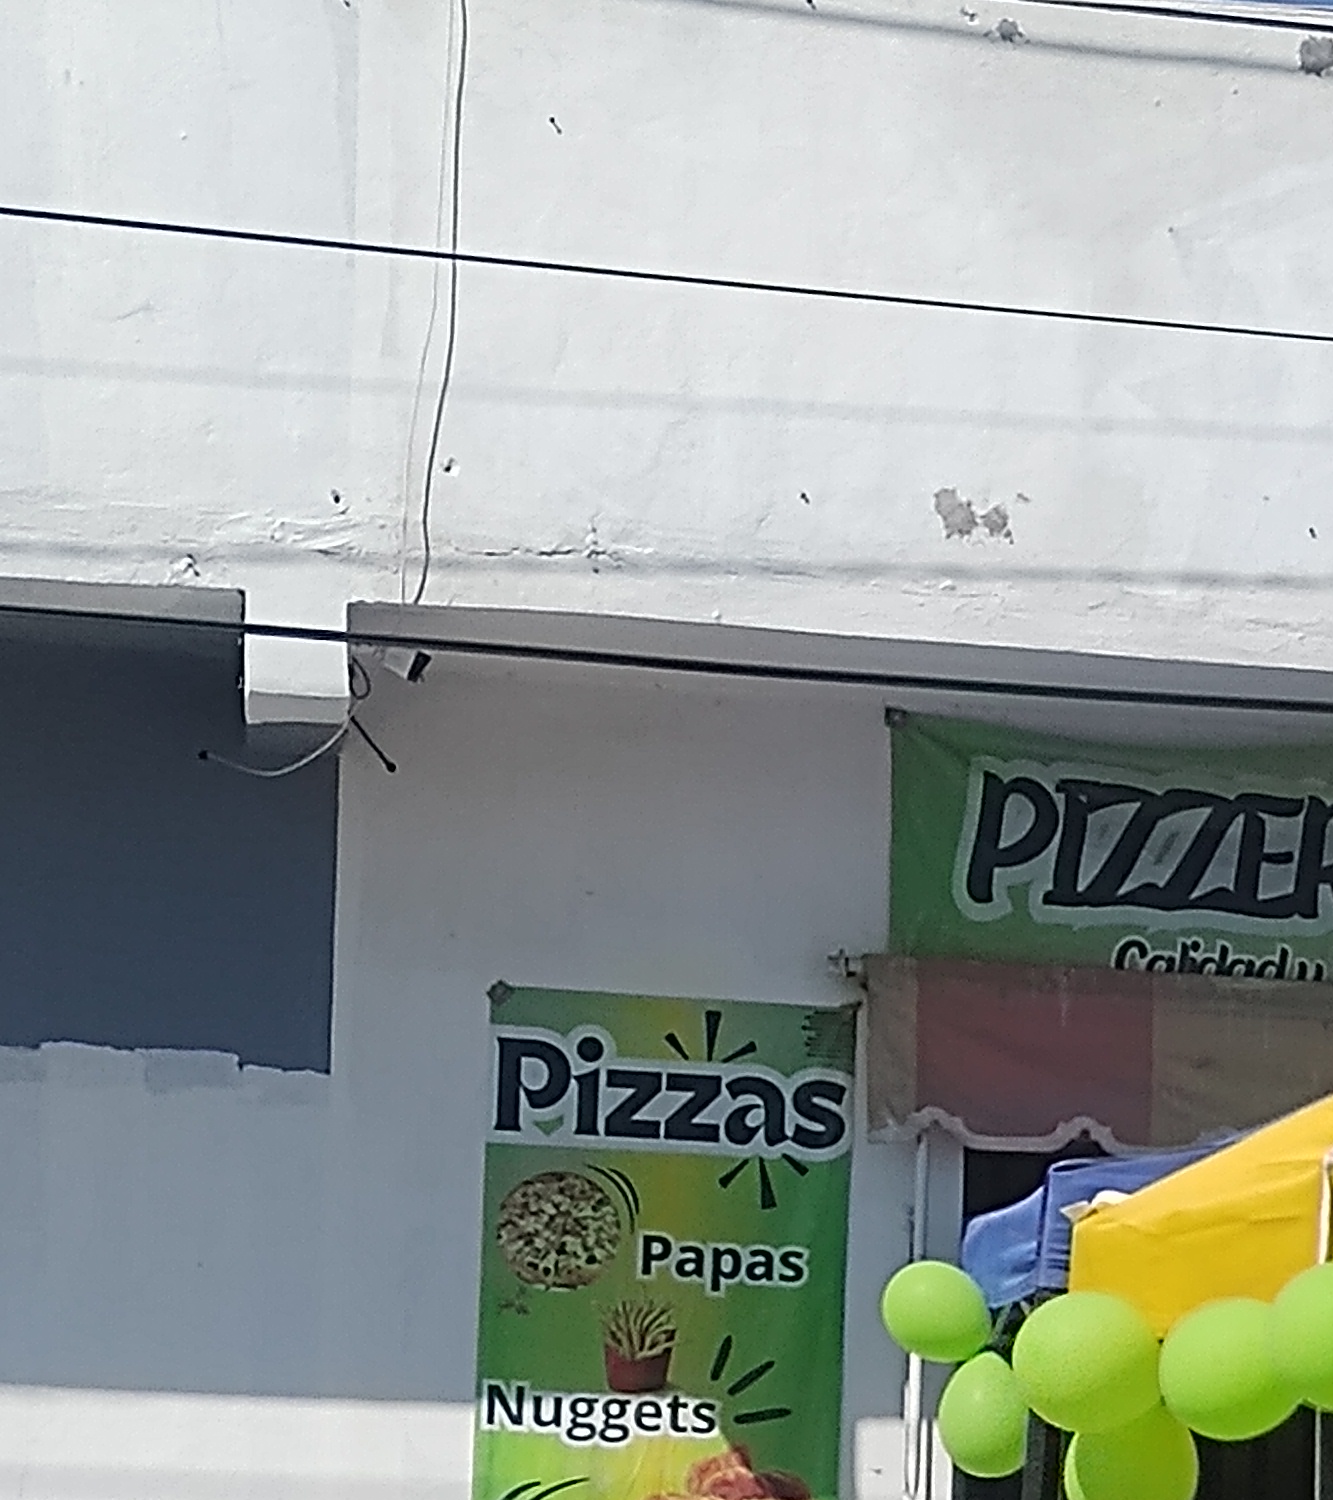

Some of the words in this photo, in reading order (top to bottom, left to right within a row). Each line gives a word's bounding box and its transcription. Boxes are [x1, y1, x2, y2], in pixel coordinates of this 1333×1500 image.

[1114, 939, 1289, 980] Calidad
[493, 1035, 847, 1151] Pizzas
[640, 1234, 805, 1292] Papas
[485, 1383, 718, 1443] Nuggets
